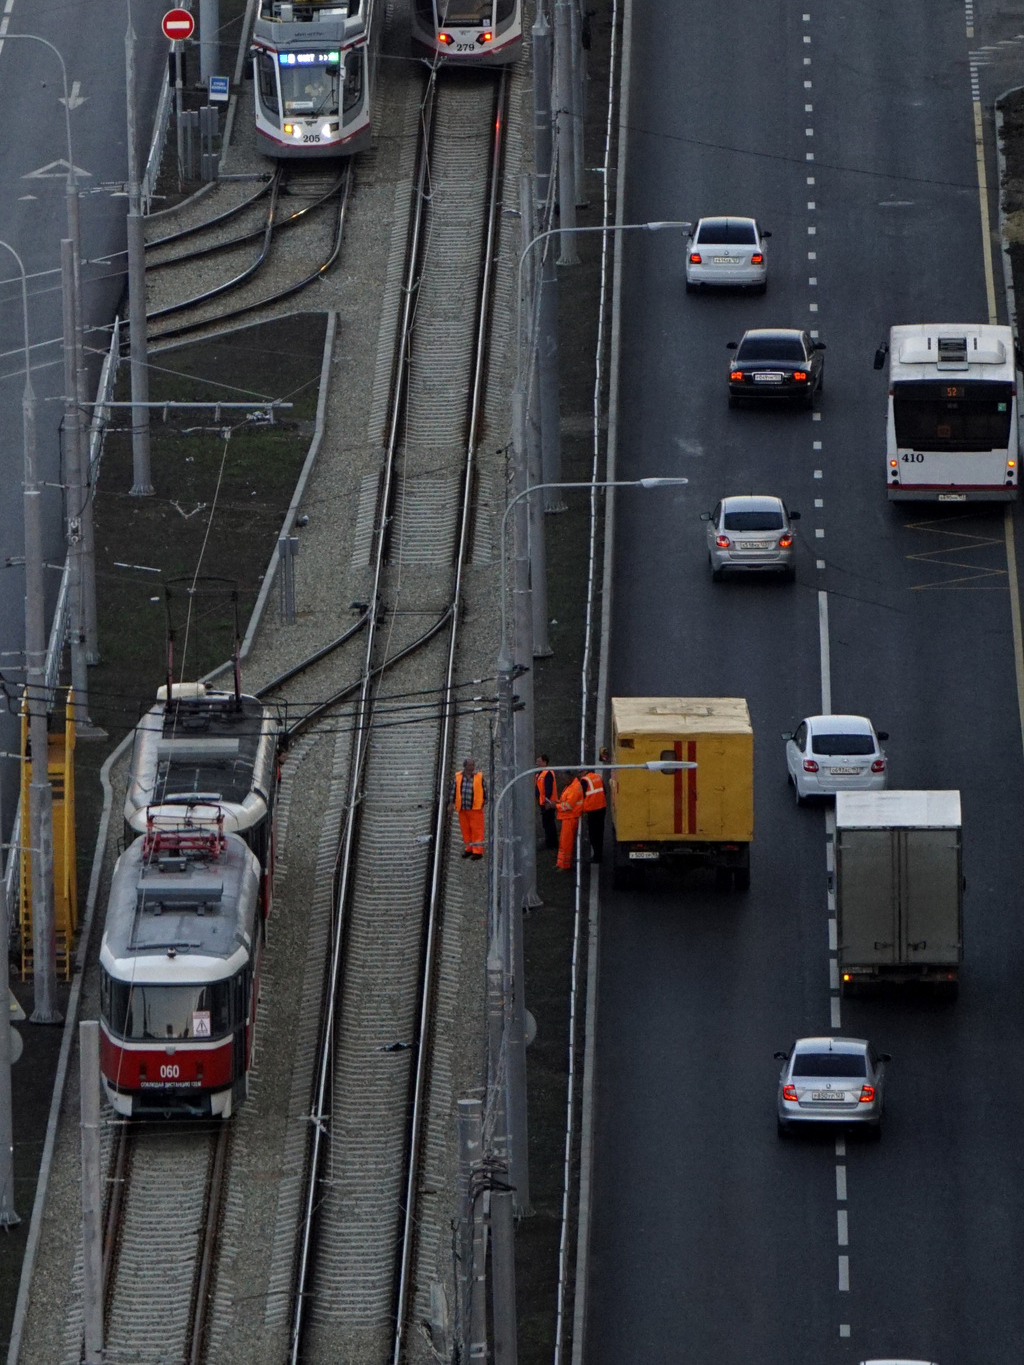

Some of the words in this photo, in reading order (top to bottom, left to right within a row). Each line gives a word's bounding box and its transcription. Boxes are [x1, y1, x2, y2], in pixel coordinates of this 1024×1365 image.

[456, 44, 475, 52] 279
[303, 135, 321, 143] 205
[946, 387, 957, 397] 52
[901, 453, 925, 463] 410
[160, 1065, 180, 1078] 060
